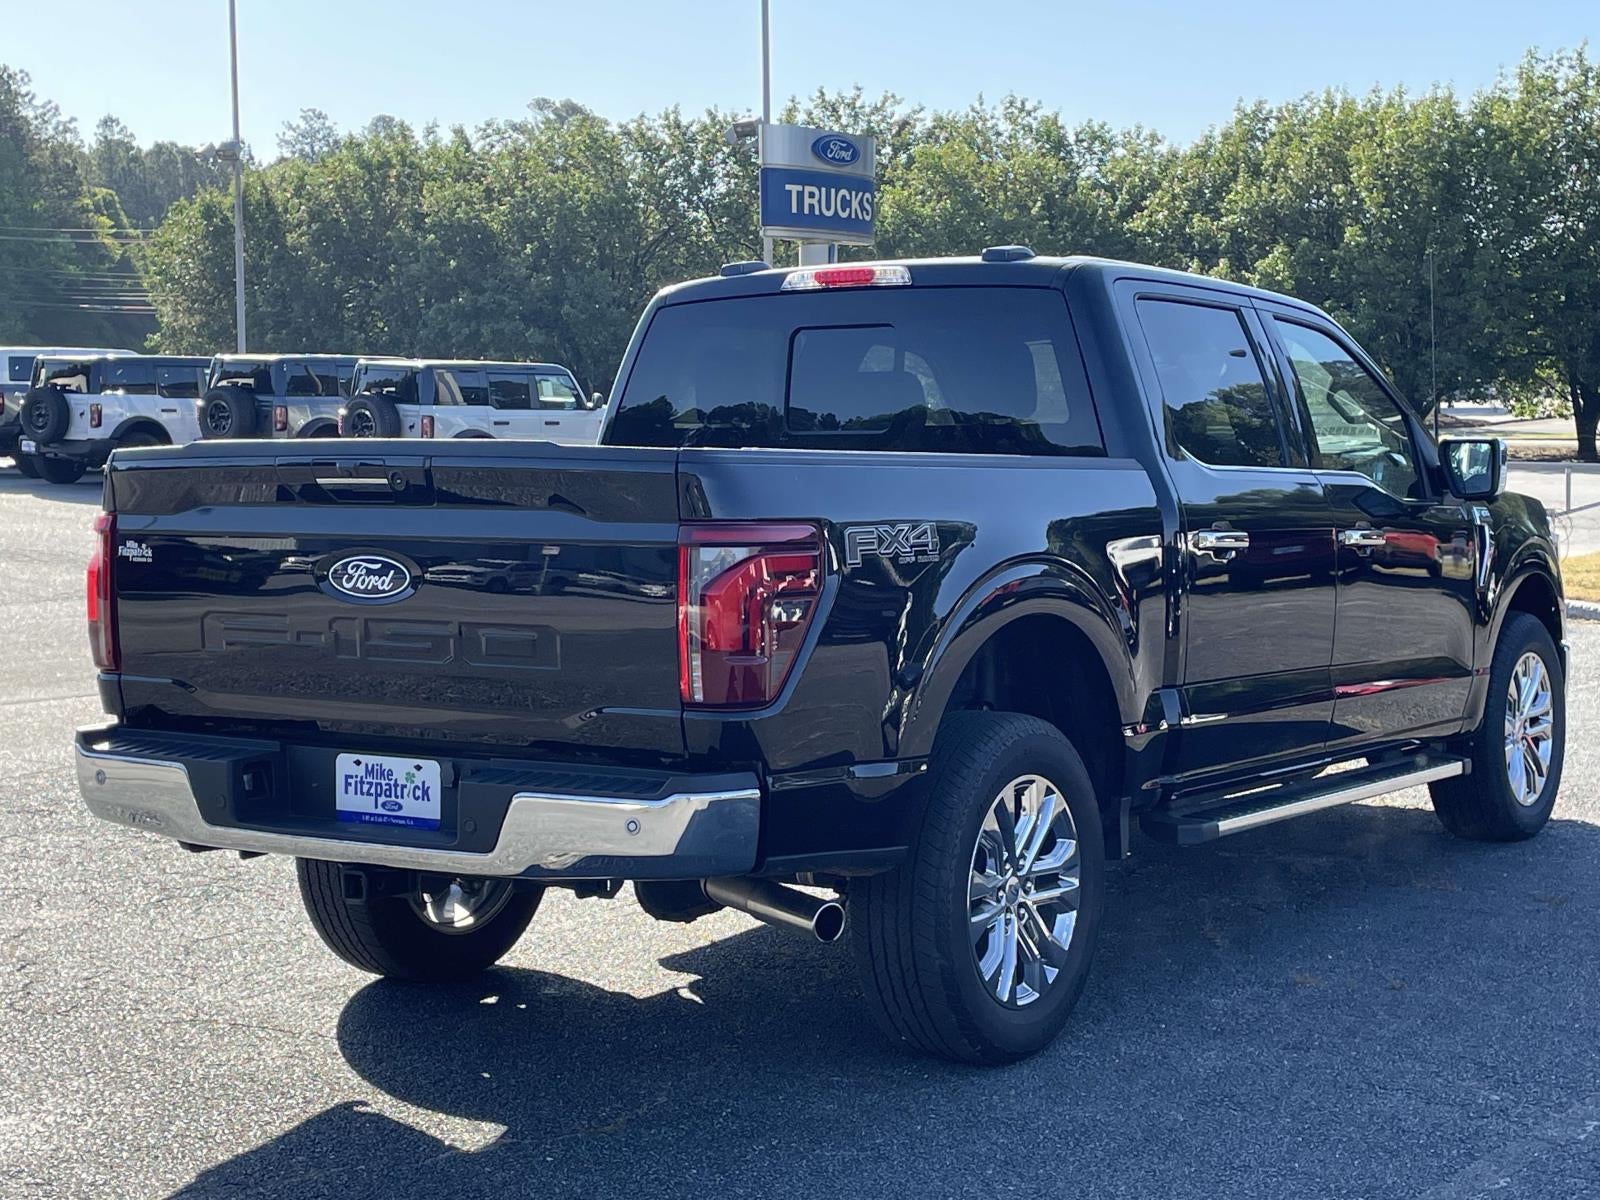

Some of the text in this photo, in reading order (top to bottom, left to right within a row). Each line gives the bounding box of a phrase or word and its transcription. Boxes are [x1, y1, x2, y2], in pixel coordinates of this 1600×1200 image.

[826, 140, 853, 161] Ford
[784, 183, 872, 221] TRUCKS
[844, 522, 939, 568] FX4
[342, 561, 395, 591] Ford
[201, 610, 562, 671] F-150
[364, 762, 394, 782] Mike
